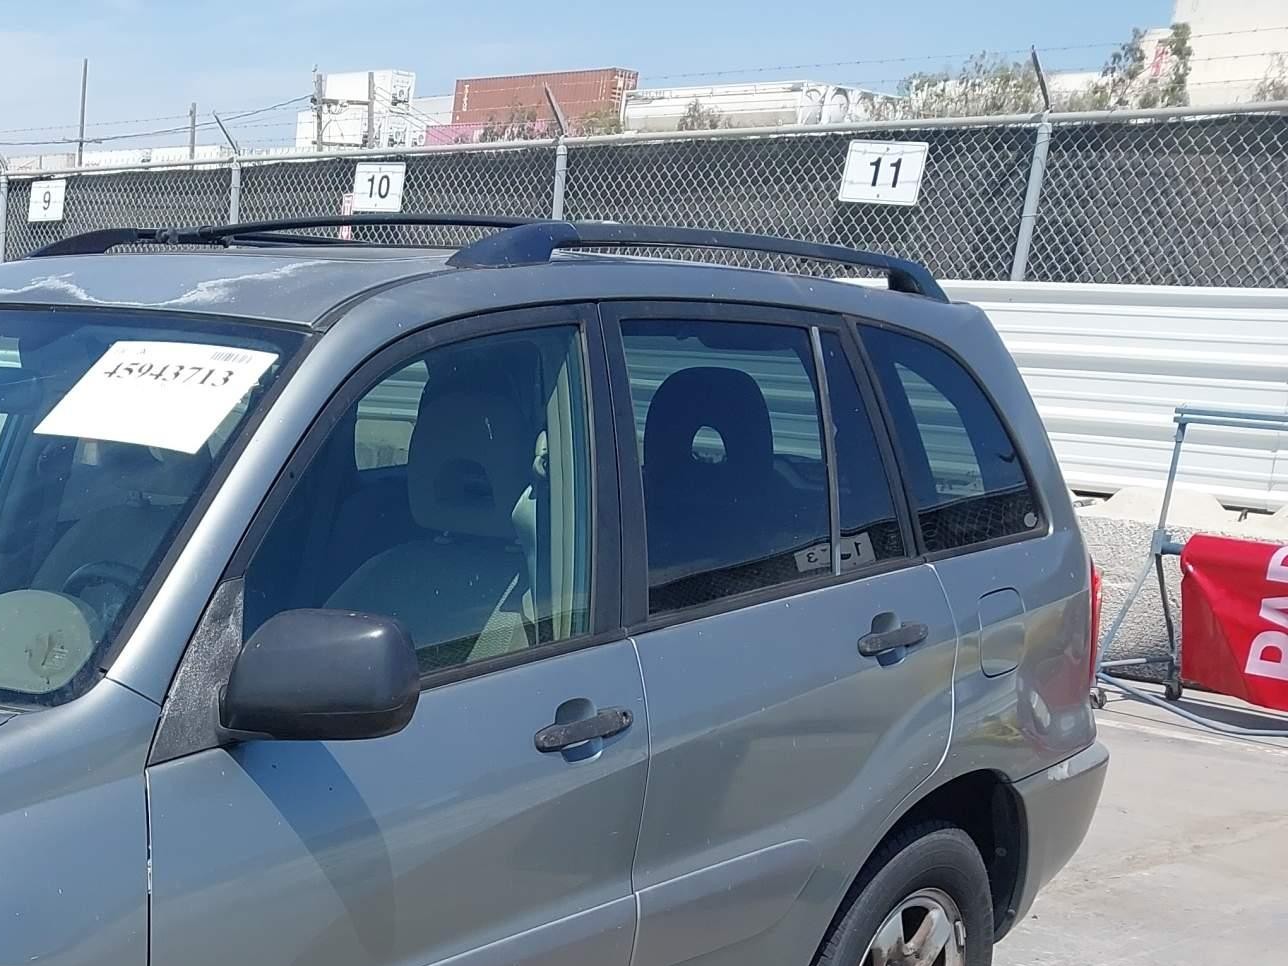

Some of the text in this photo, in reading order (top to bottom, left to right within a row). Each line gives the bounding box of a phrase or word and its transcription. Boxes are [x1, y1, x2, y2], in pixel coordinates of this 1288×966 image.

[869, 157, 903, 189] 11
[367, 174, 390, 199] 10
[42, 191, 51, 210] 9
[103, 361, 235, 388] 45943713
